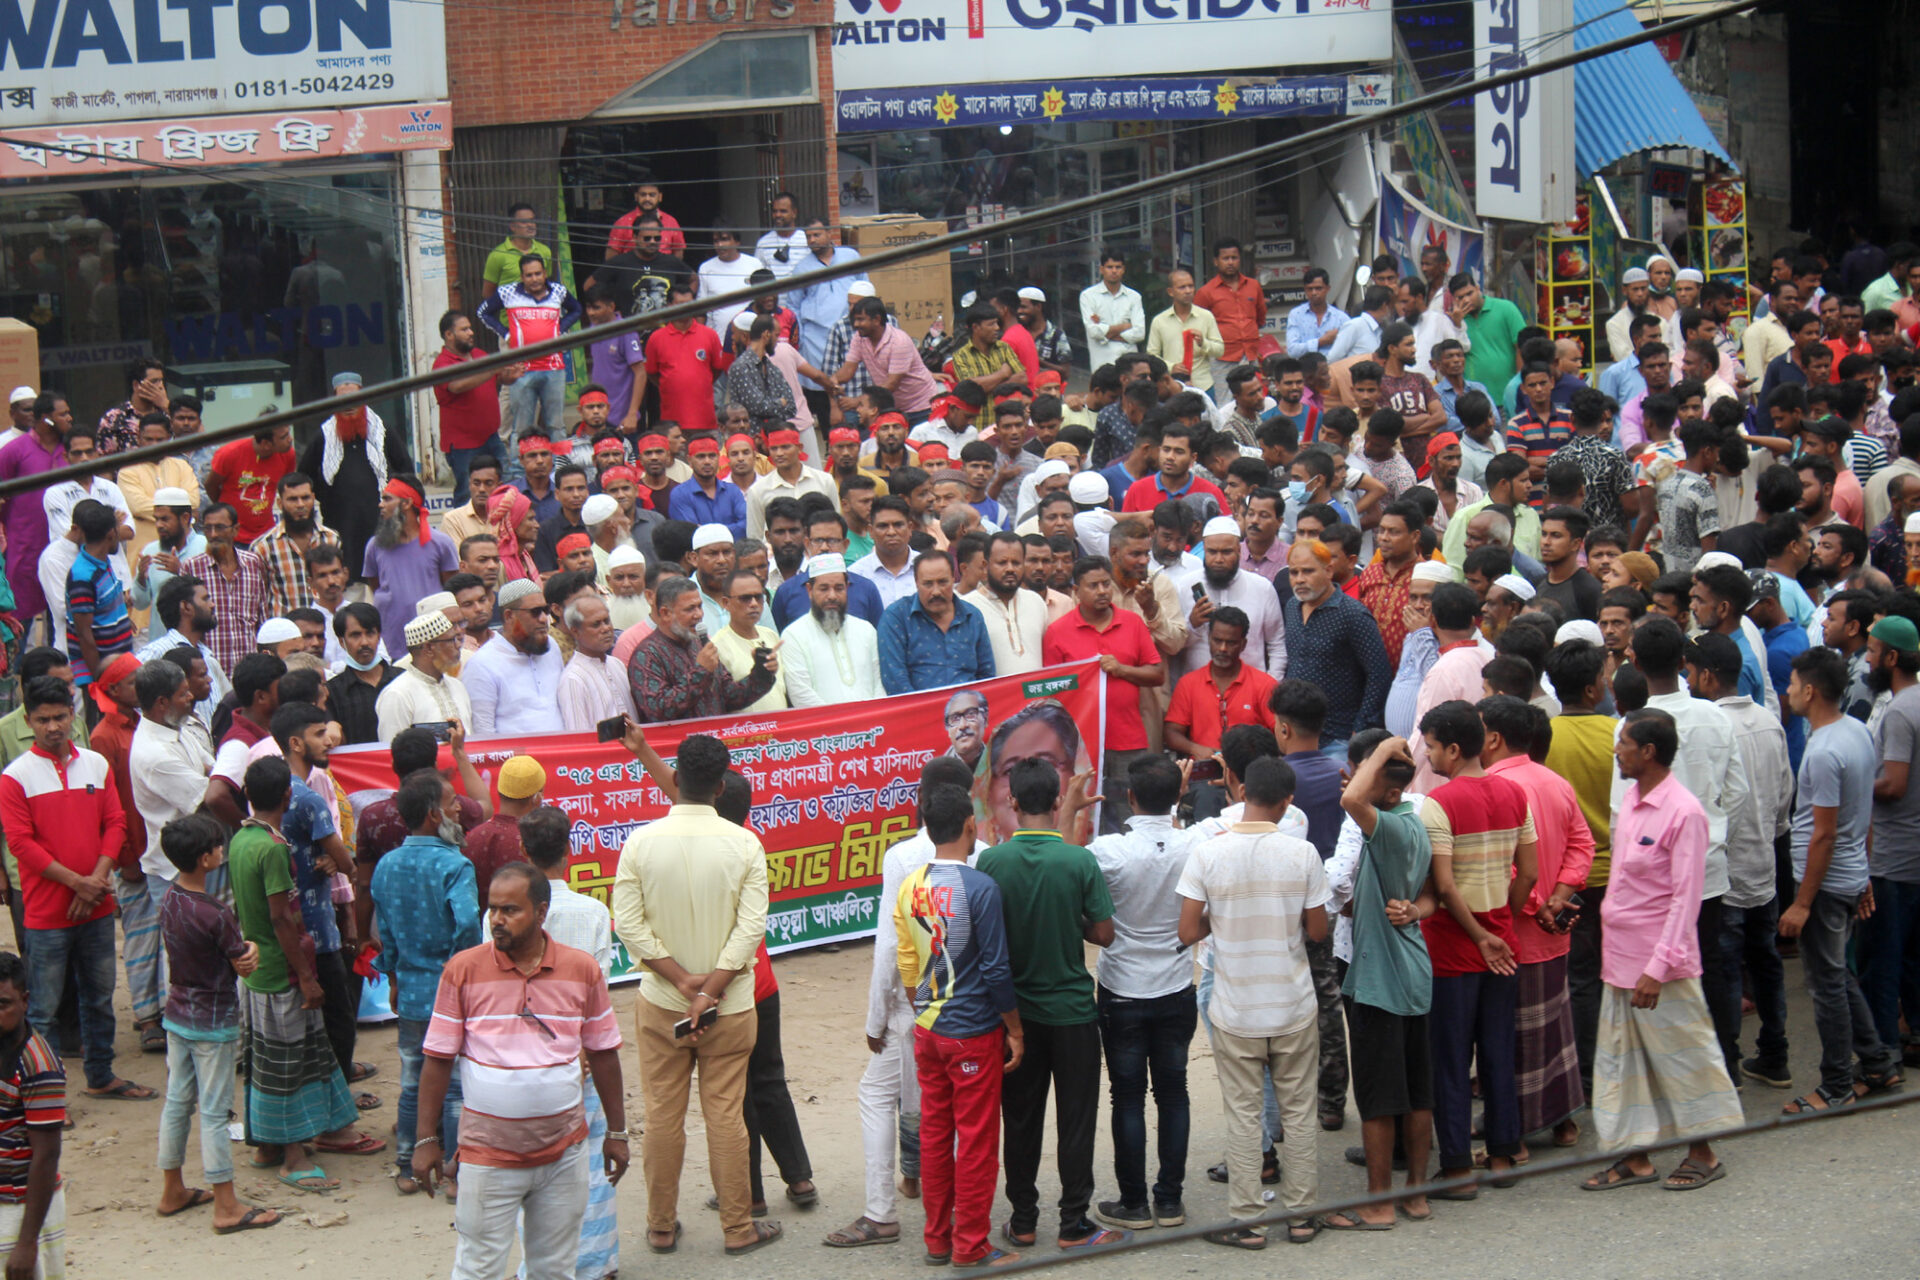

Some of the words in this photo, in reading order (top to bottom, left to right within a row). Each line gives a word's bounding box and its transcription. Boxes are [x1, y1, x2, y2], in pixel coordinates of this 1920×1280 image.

[0, 0, 392, 71] WALTON
[316, 56, 364, 69] আমাদের
[370, 54, 392, 66] পণ্য
[51, 91, 78, 109] কাজী
[82, 89, 120, 108] মার্কেট,
[124, 90, 161, 105] পাগলা,
[235, 73, 394, 98] 0181-5042429
[840, 96, 881, 119] ওয়ালটন
[885, 99, 904, 118] পণ্য
[908, 98, 931, 117] এখন
[940, 97, 954, 116] ৬
[964, 96, 986, 115] মাসে
[989, 94, 1011, 114] নগদ
[1013, 94, 1037, 118] মূল্যে
[1047, 95, 1061, 112] ৮
[1069, 92, 1088, 110] মাসে
[1352, 99, 1387, 107] WALTON
[154, 125, 260, 161] ফ্রিজ
[270, 118, 334, 153] ফ্রি
[400, 123, 442, 133] WALTON
[162, 301, 385, 361] WALTON
[631, 340, 640, 351] 3
[58, 345, 144, 364] WALTON
[1390, 391, 1427, 412] USA
[423, 497, 455, 510] ALTO
[722, 721, 778, 738] সর্বশক্তিমান
[597, 764, 623, 783] এর
[765, 738, 810, 761] দাঁড়াও
[603, 787, 643, 810] সফল
[770, 757, 834, 789] প্রধানমন্ত্রী
[839, 755, 869, 779] শেখ
[871, 747, 936, 777] হাসিনাকে
[749, 793, 801, 835] হুমকির
[804, 797, 819, 820] ও
[878, 776, 922, 811] প্রতিব
[811, 892, 876, 929] আঞ্চলিক
[911, 886, 956, 918] JEWEL
